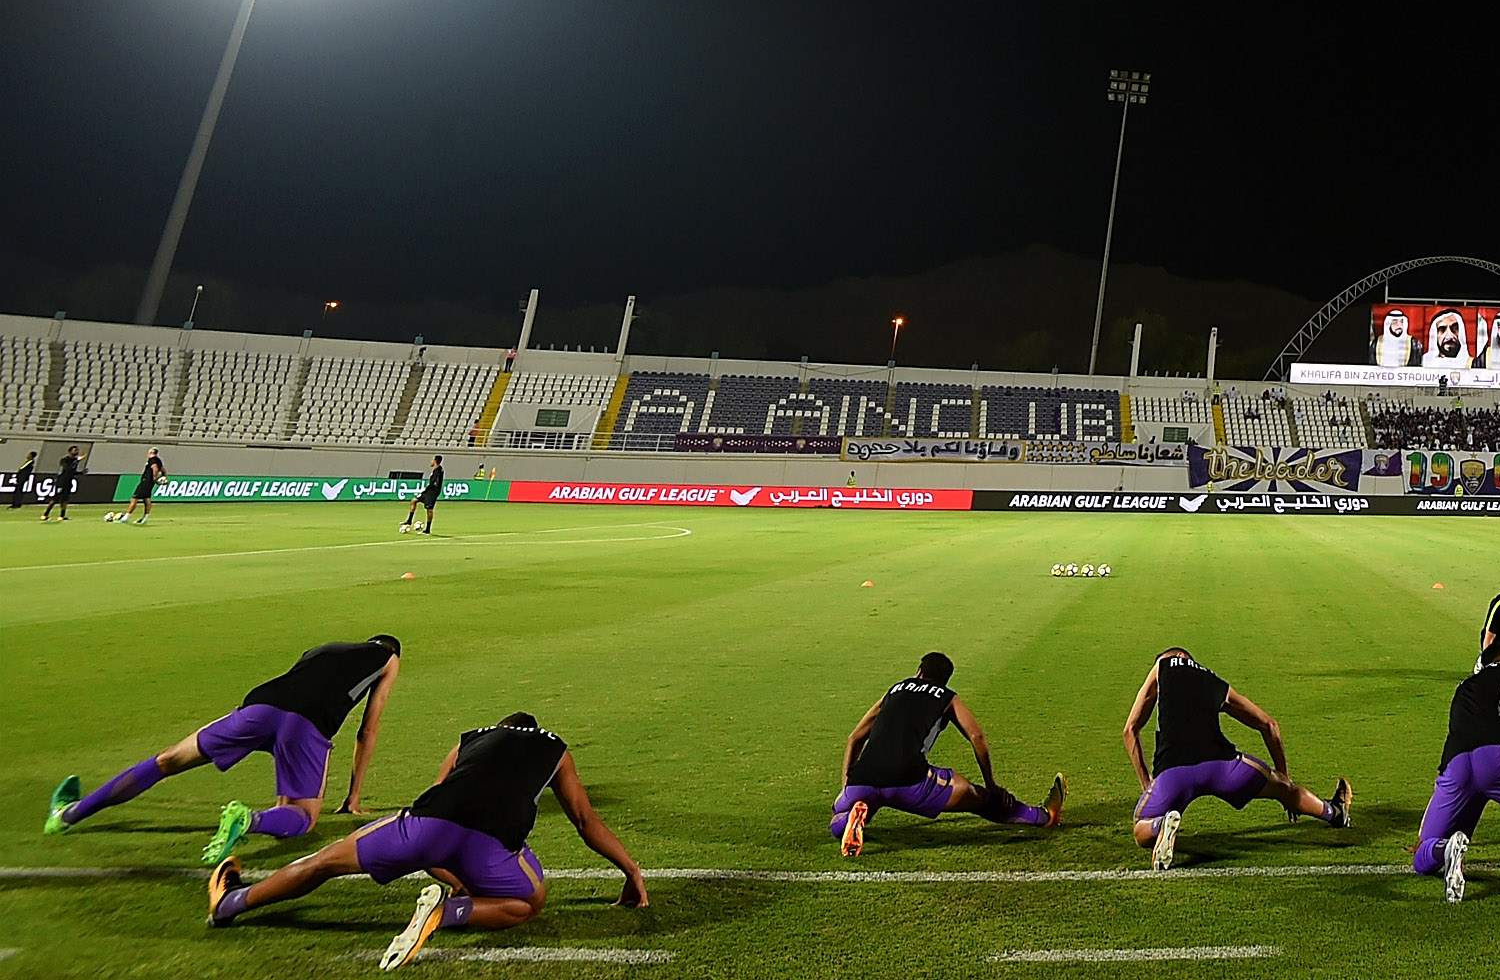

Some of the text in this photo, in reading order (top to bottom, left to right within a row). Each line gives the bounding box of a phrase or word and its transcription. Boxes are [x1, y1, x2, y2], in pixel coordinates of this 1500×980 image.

[1301, 370, 1440, 382] KHALIFA BIN ZAYED STADIUM
[154, 480, 224, 497] ARABIAN
[223, 481, 260, 498] GULF
[353, 479, 397, 499] العربي
[443, 483, 469, 499] دوري
[549, 486, 616, 501] ARABIAN
[618, 487, 658, 501] GULF
[769, 488, 934, 507] دوري الخليج العربي
[1009, 494, 1072, 508] ARABIAN
[1074, 495, 1111, 508] GULF
[1216, 494, 1369, 513] دوري الخليج العربي
[1416, 500, 1459, 511] ARABIAN
[1460, 501, 1486, 511] GULF
[1170, 657, 1184, 667] AL
[928, 685, 945, 699] FC
